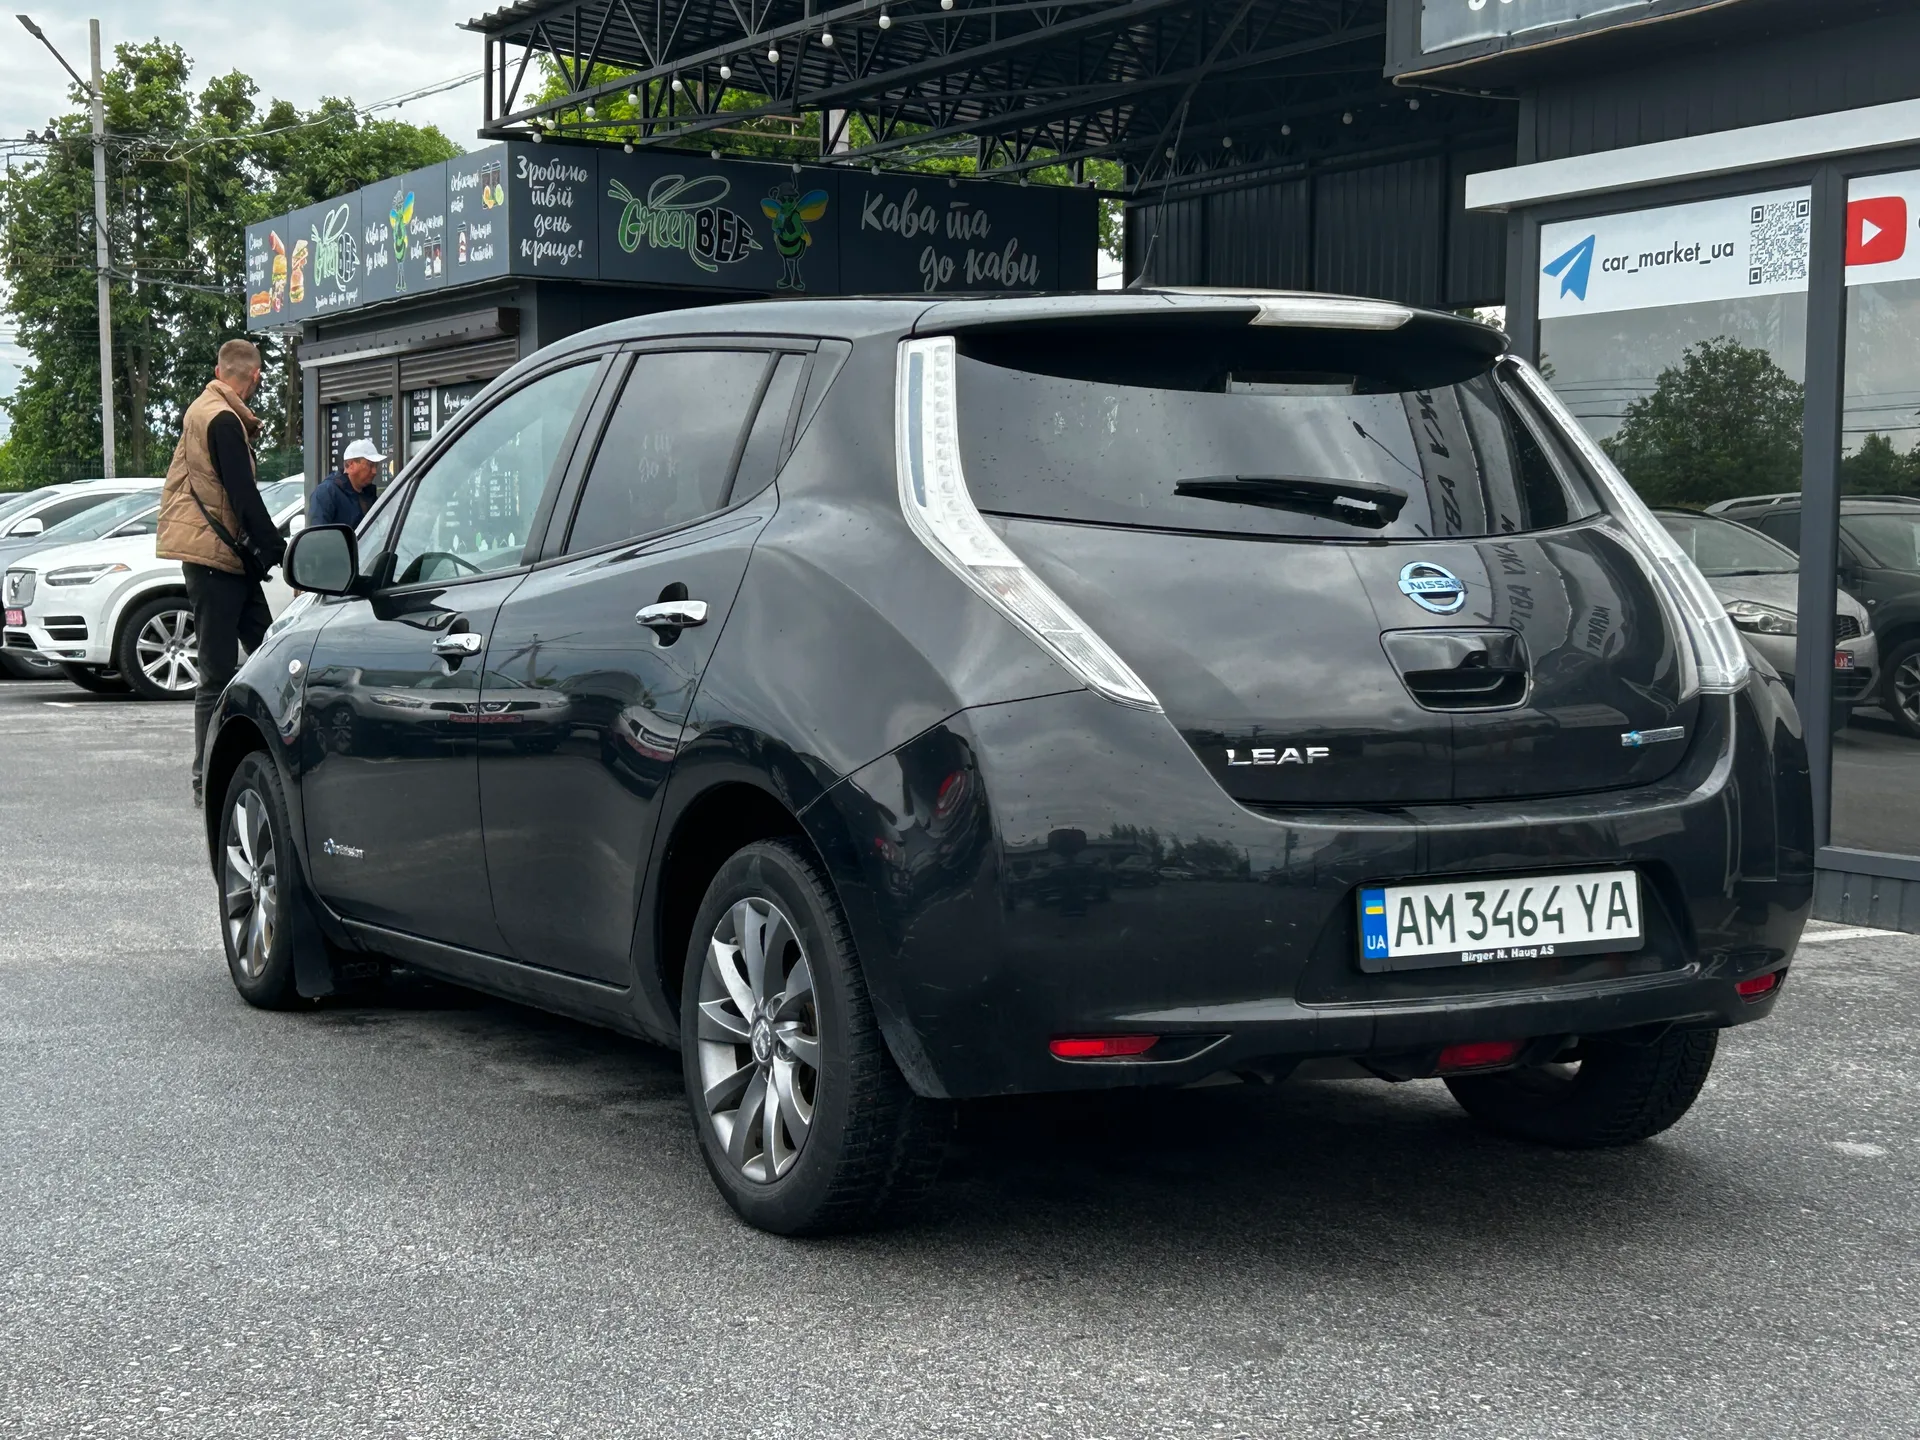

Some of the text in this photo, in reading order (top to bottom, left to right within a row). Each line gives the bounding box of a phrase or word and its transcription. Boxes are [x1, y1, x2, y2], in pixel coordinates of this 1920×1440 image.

[517, 155, 588, 188] Зробимо
[531, 182, 574, 208] твій
[534, 213, 572, 238] день
[861, 187, 991, 240] Кава та
[520, 238, 584, 266] краще!
[920, 237, 1040, 292] до кави
[1602, 240, 1735, 274] car_market_ua
[1226, 747, 1330, 766] LEAF
[1395, 881, 1632, 947] AM 3464 YA
[1367, 935, 1387, 950] UA
[1461, 945, 1555, 963] Birger N. Haug AS
